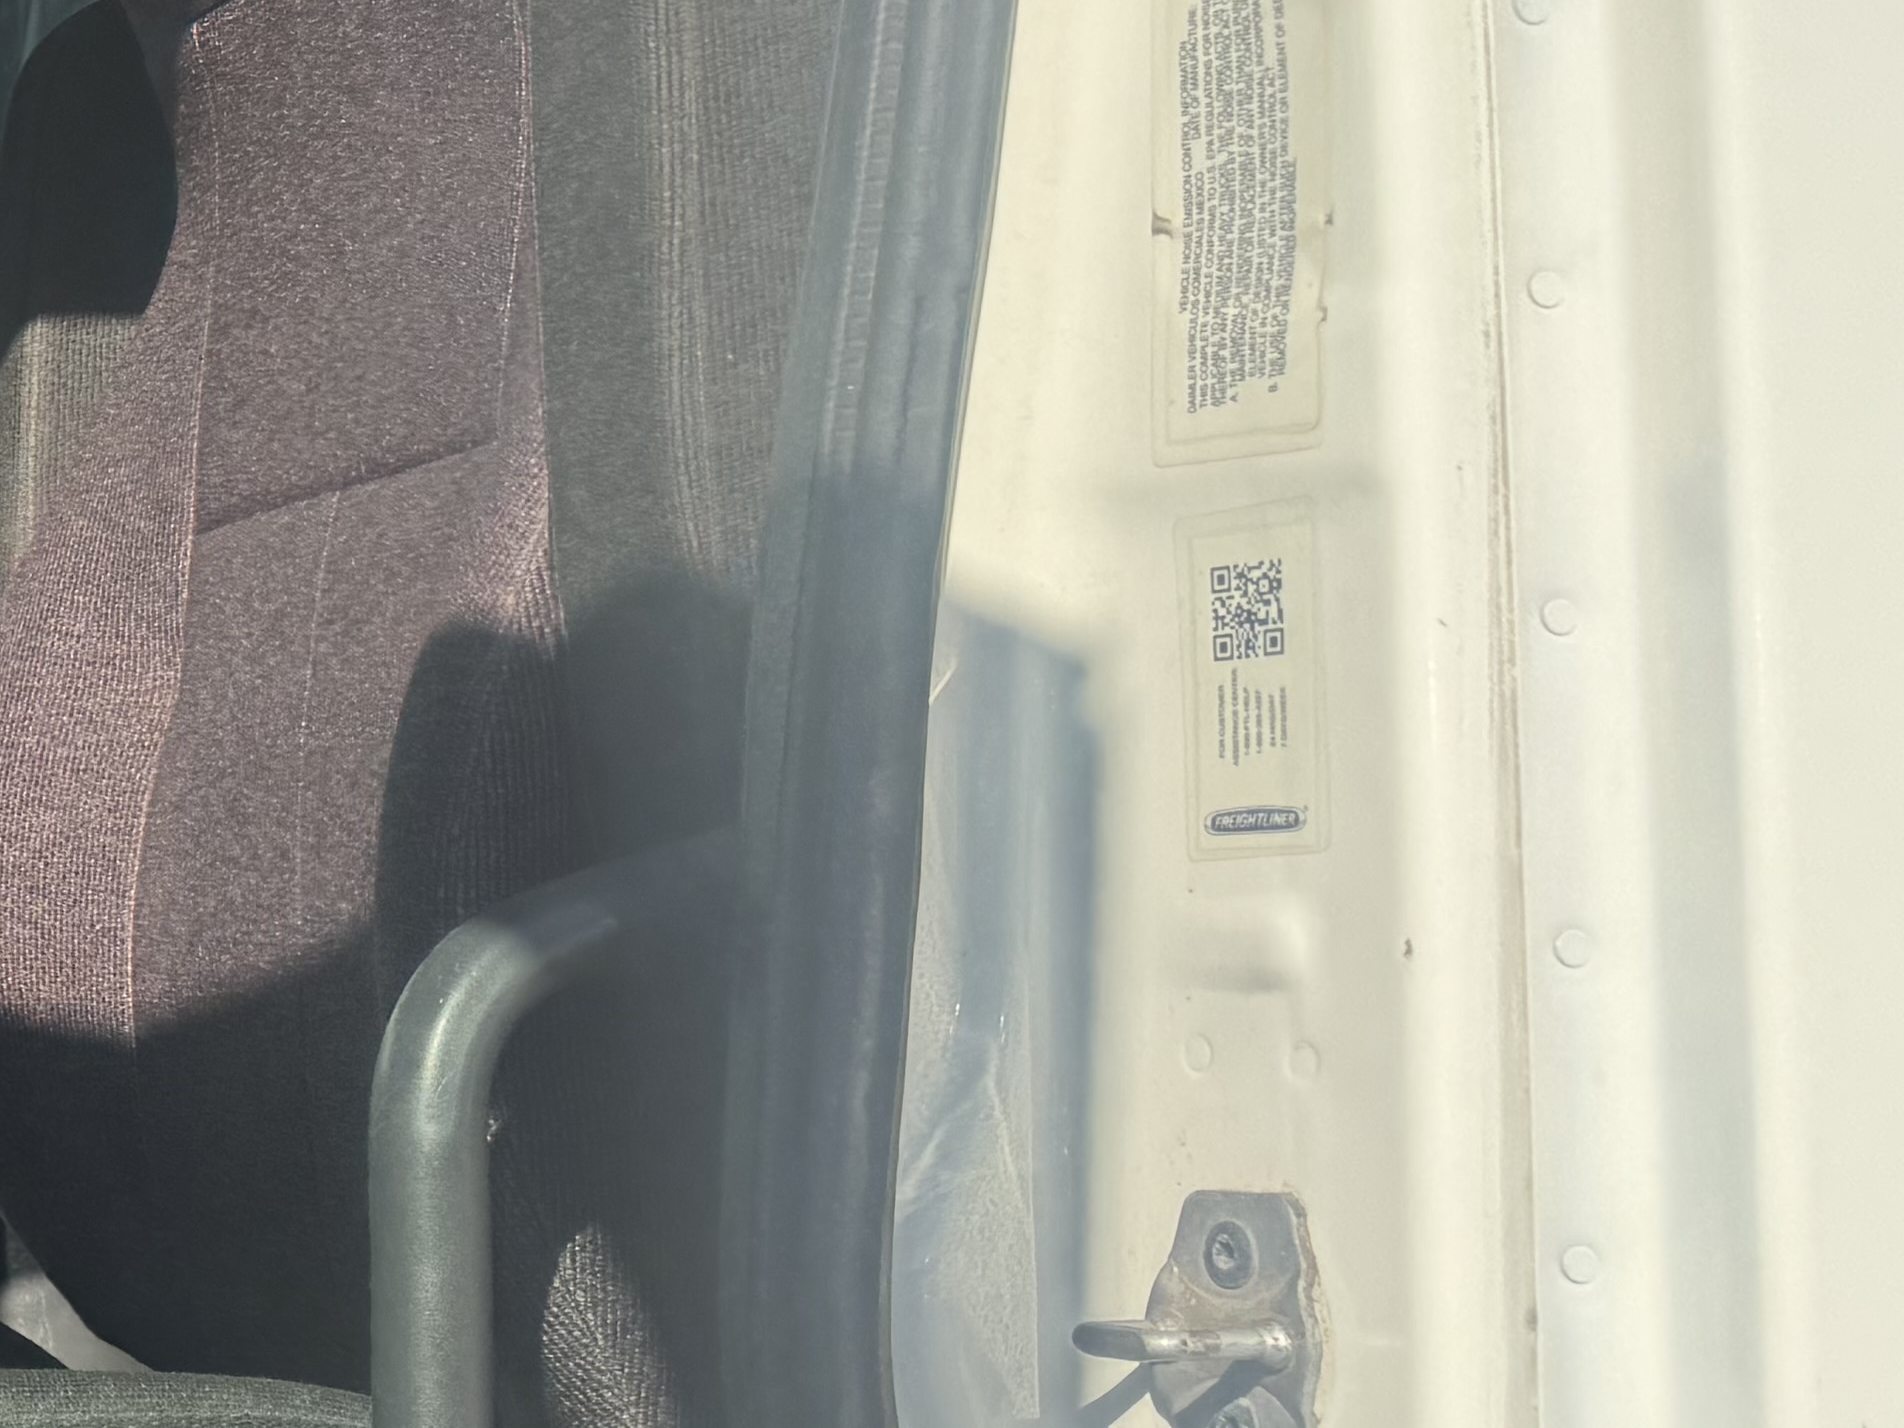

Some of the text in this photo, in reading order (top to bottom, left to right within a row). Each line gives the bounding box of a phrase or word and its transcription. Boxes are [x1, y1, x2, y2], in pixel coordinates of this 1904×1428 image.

[1202, 33, 1212, 56] FOR
[1183, 175, 1193, 227] EMISSION
[1206, 187, 1216, 202] TO
[1187, 365, 1197, 414] DAIMLER
[1195, 171, 1204, 216] MEXICO
[1200, 321, 1210, 381] COMPLETE
[1199, 383, 1208, 409] THIS
[1215, 812, 1297, 830] FREIGHTLINER
